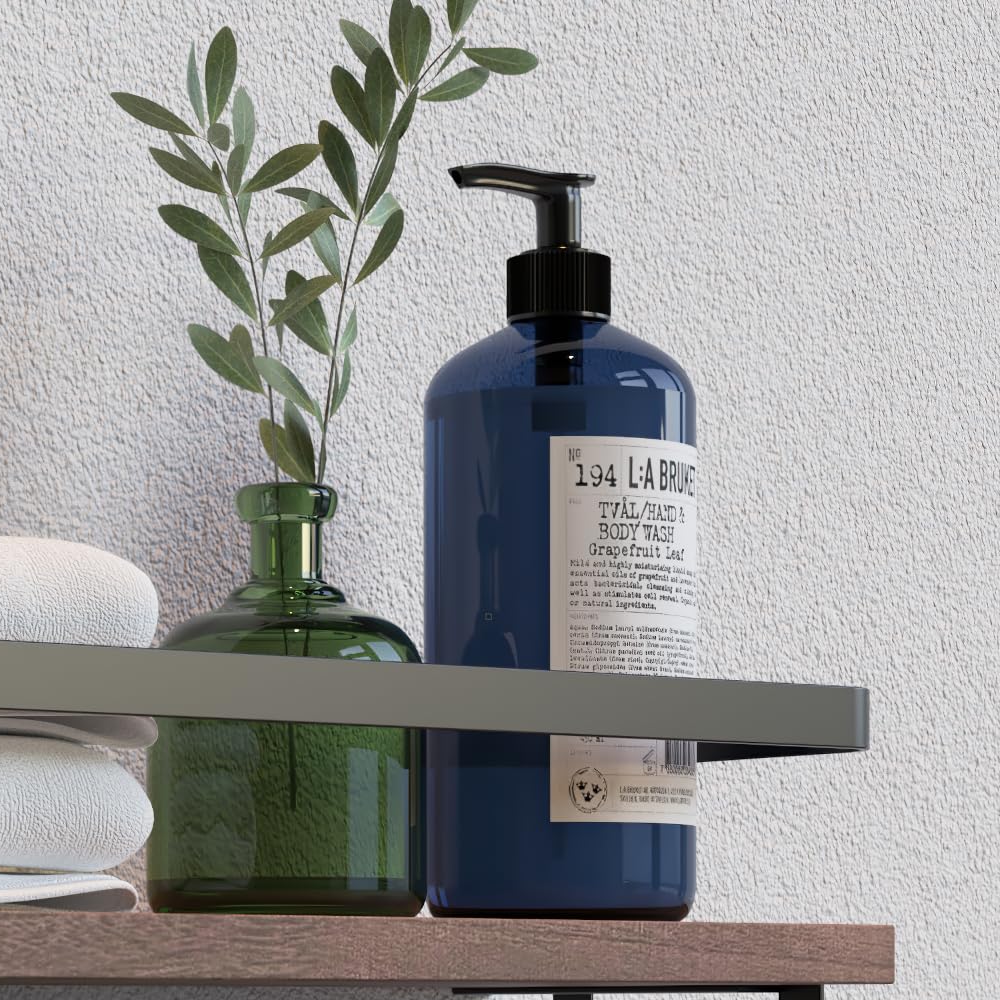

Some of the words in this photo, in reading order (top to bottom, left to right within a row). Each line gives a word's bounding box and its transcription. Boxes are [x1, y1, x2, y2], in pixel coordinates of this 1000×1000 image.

[575, 463, 618, 487] 194
[628, 456, 654, 489] L:A
[598, 522, 641, 540] BODY
[642, 524, 675, 543] WASH
[588, 543, 660, 559] Grapefruit
[608, 561, 632, 570] highly
